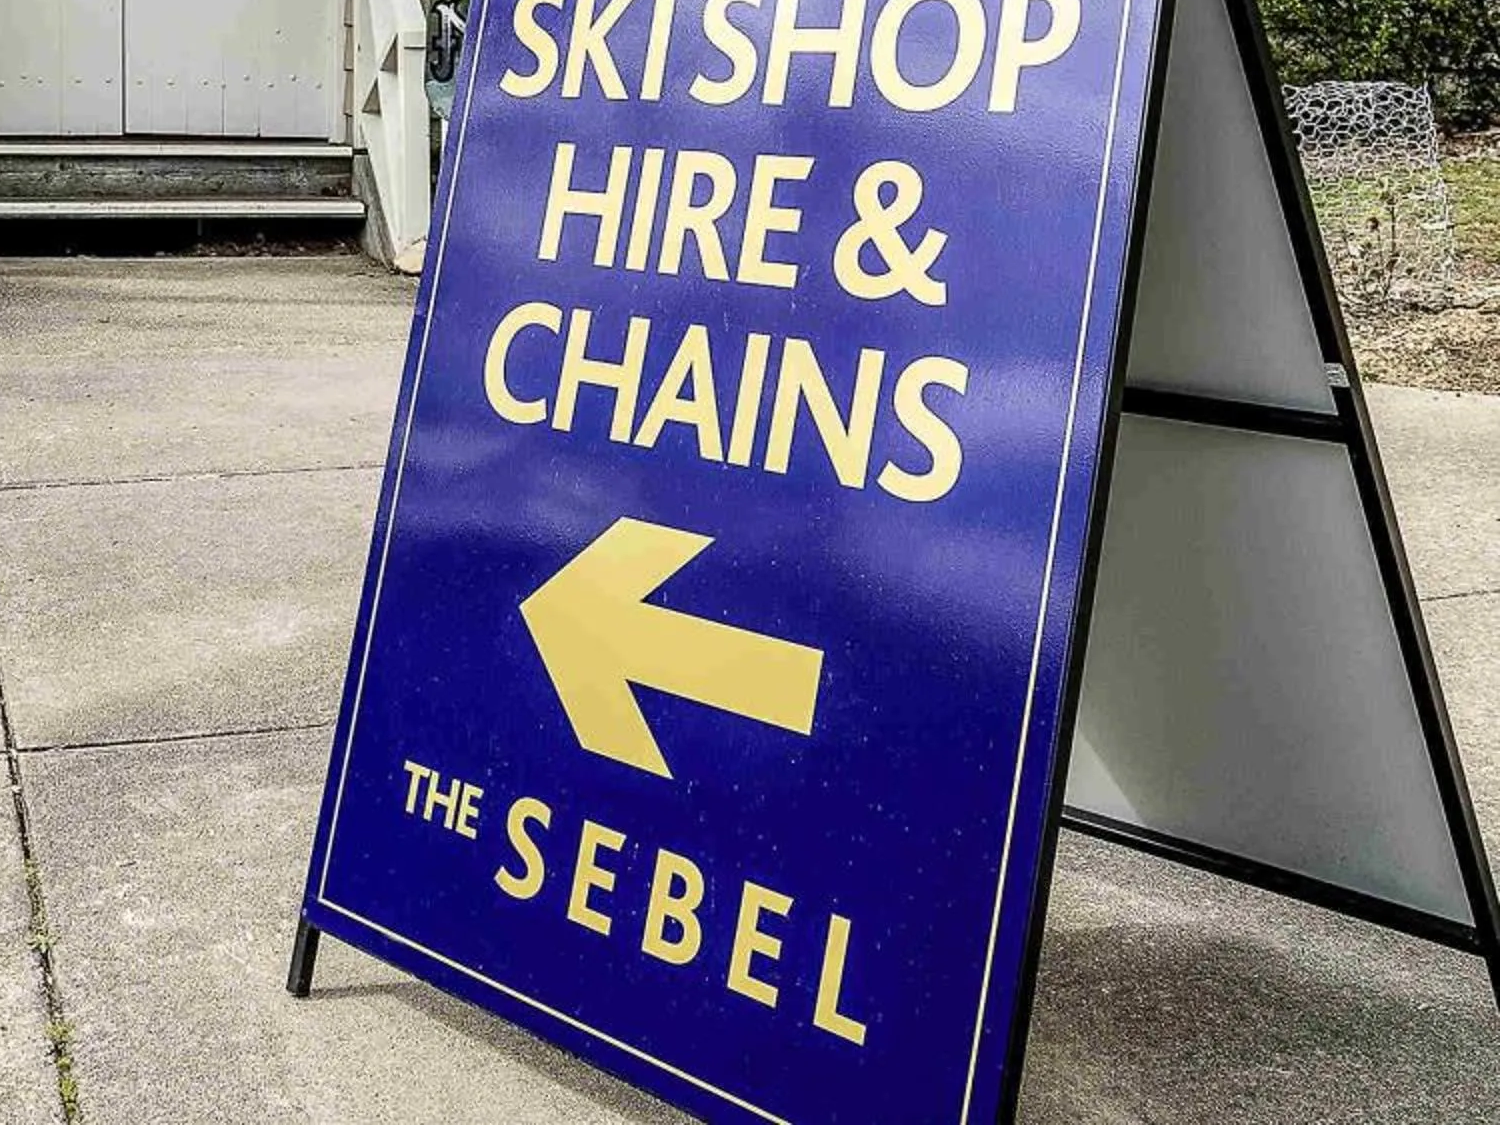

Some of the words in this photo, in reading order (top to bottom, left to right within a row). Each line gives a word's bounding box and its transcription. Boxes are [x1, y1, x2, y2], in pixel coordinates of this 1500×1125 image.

[537, 142, 816, 289] HIRE
[832, 160, 950, 306] &
[483, 301, 970, 503] CHAINS
[403, 760, 483, 840] THE
[494, 796, 868, 1046] SEBEL
